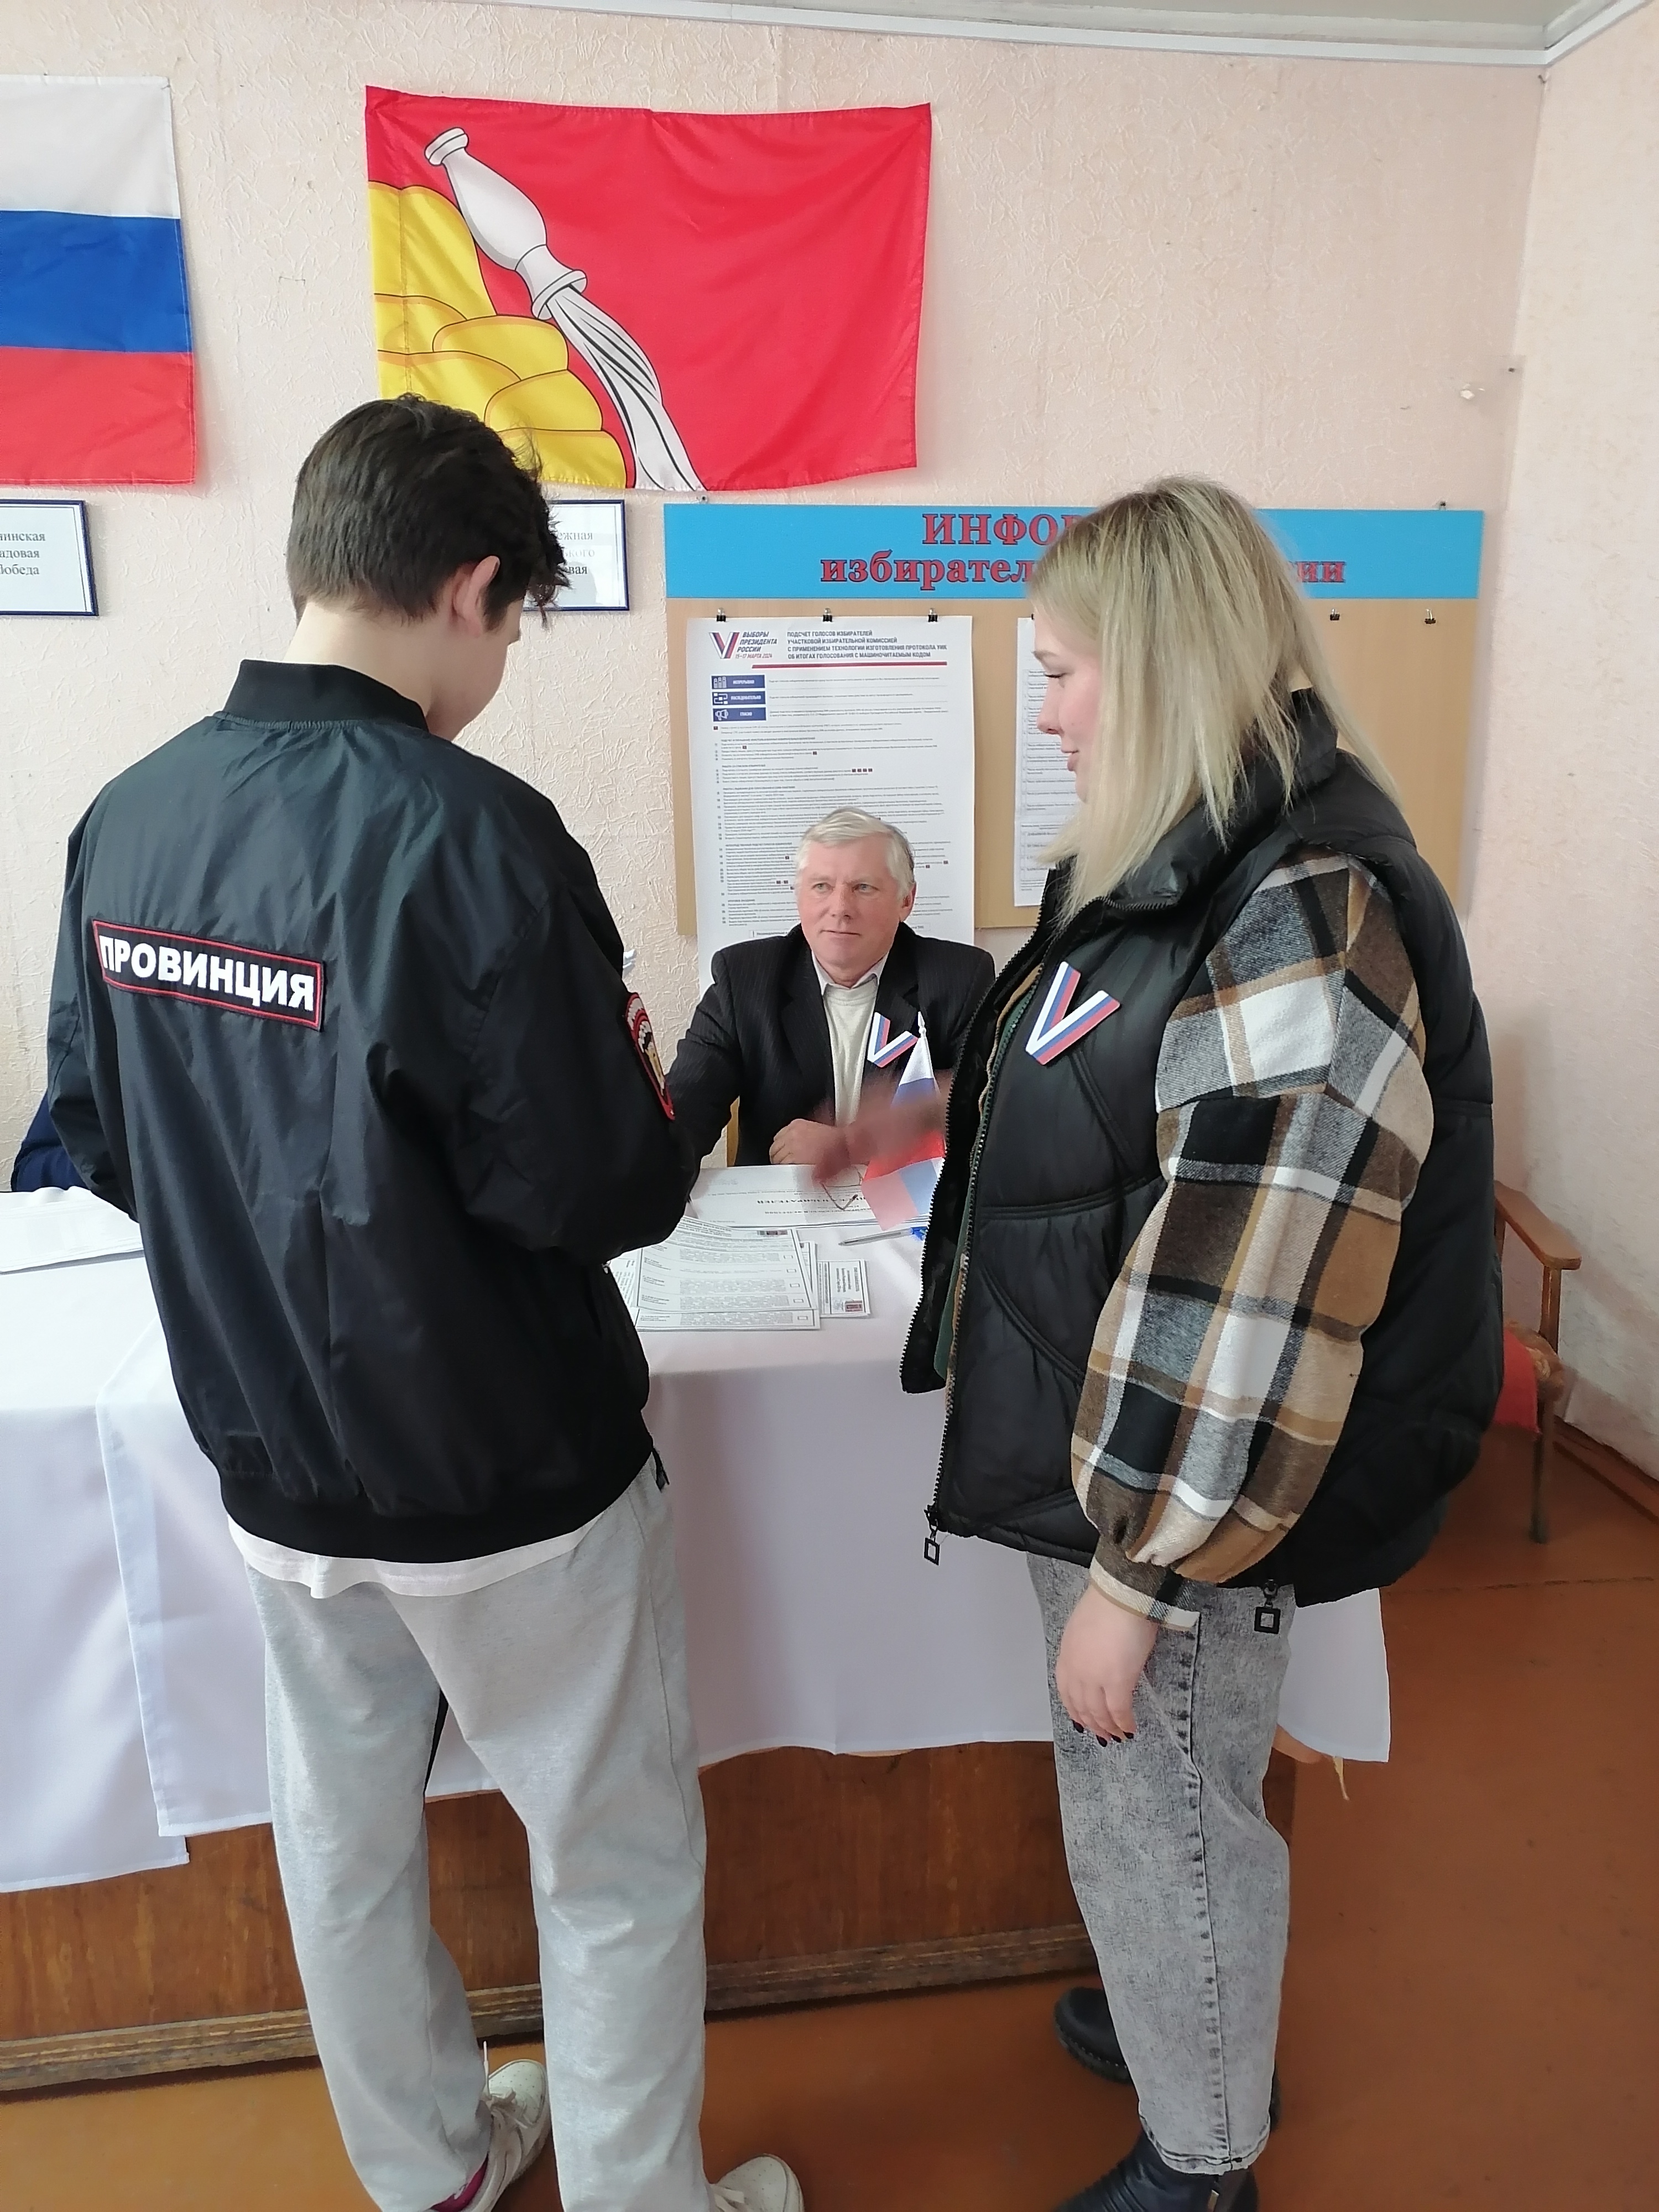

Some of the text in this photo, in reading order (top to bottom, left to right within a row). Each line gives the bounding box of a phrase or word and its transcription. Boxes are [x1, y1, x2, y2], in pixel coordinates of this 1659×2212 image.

[821, 549, 1347, 591] избирател ии
[99, 935, 314, 1011] ПРОВИНЦИЯ
